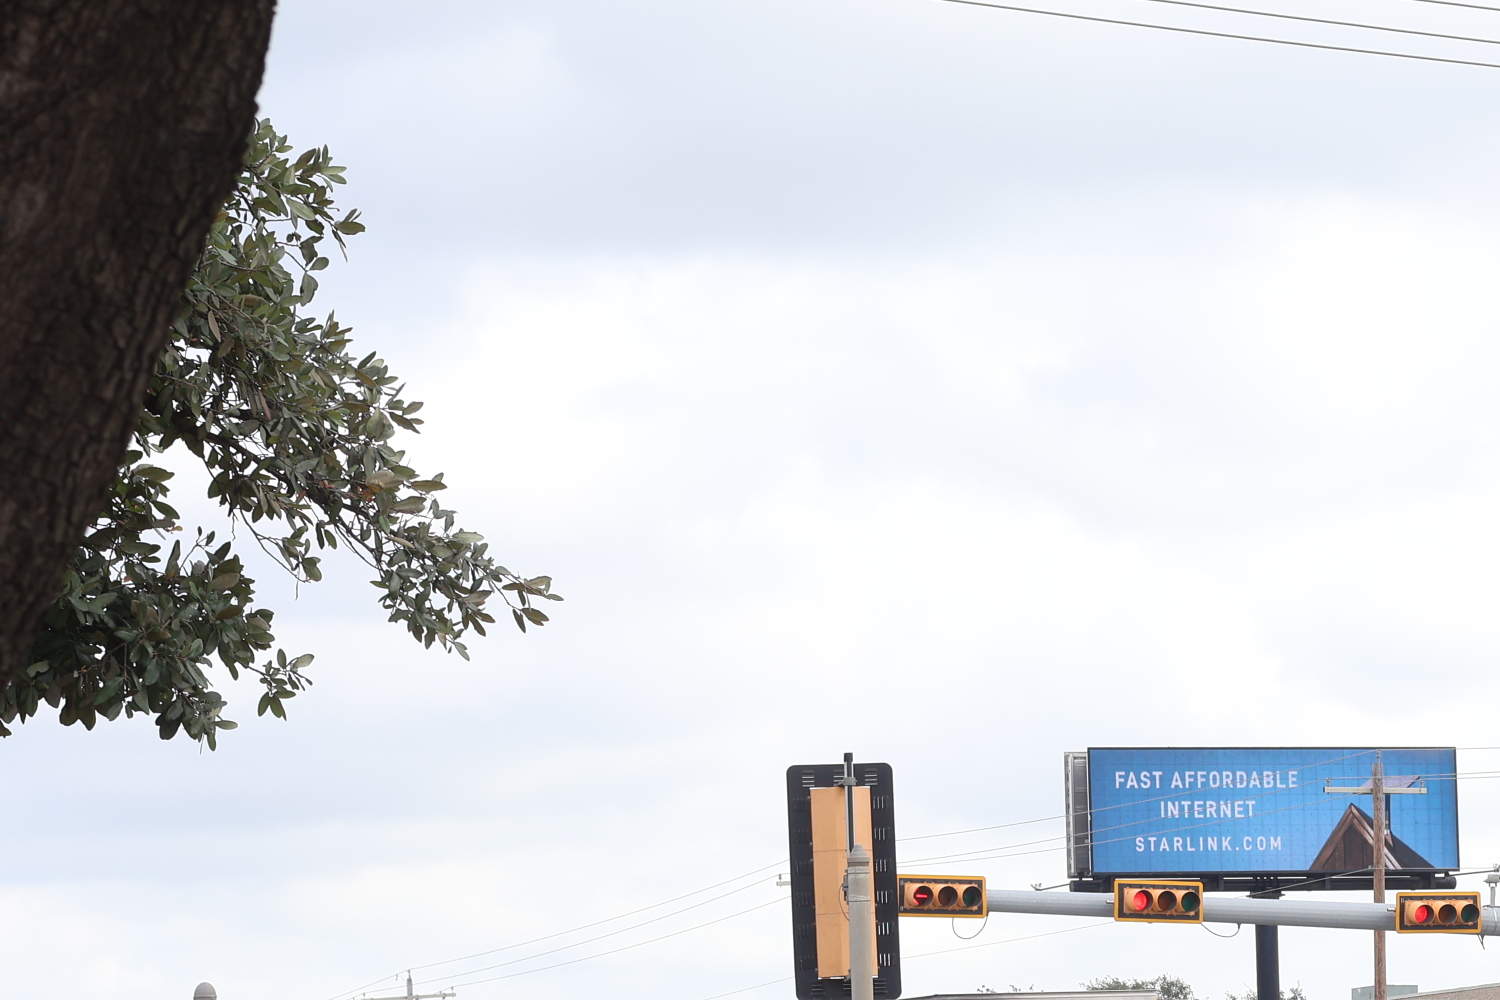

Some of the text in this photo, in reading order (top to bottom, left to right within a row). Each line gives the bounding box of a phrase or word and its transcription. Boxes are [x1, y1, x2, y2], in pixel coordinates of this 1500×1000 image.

[1115, 771, 1299, 789] FAST AFFORDABLE
[1160, 800, 1256, 819] INTERNET
[1135, 836, 1282, 852] STARLINK.COM
